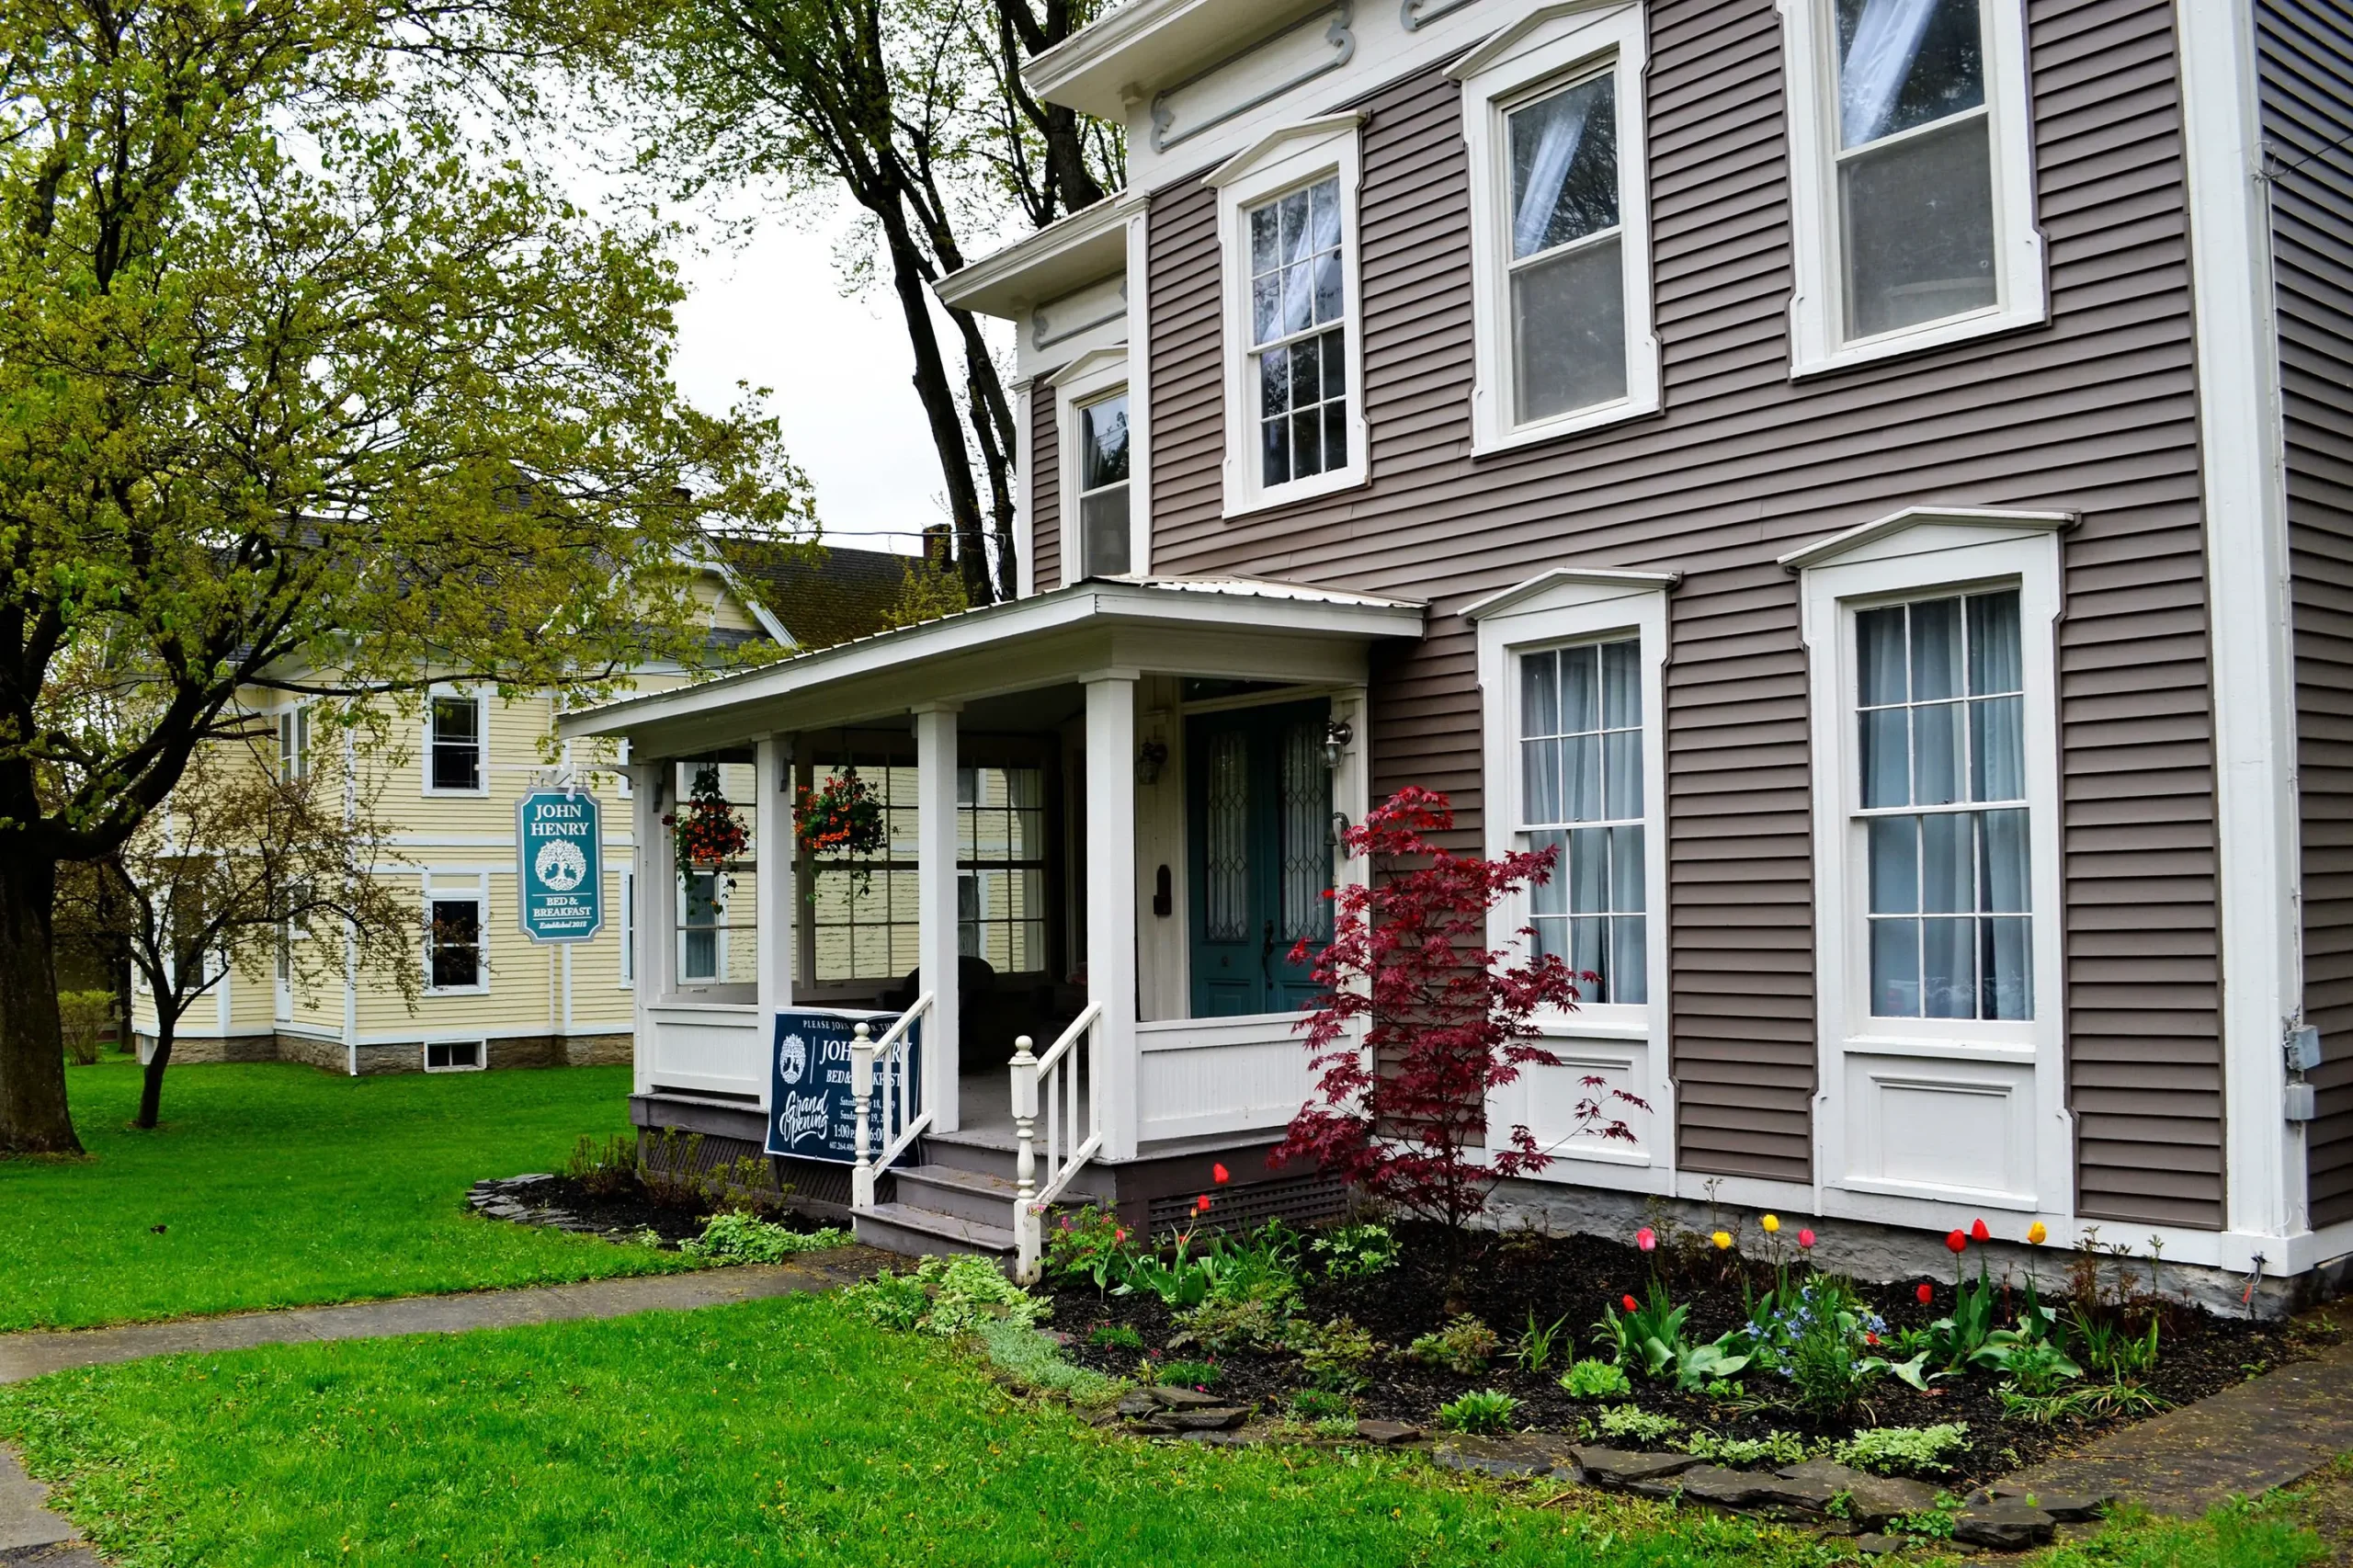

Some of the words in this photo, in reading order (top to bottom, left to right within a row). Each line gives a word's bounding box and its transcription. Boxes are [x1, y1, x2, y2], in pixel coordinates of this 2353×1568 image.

[534, 804, 582, 821] JOHN
[530, 822, 589, 836] HENRY
[546, 897, 567, 906] BED
[569, 896, 579, 905] &
[533, 906, 592, 917] BREAKFAST
[802, 1019, 831, 1029] PLEASE
[819, 1040, 852, 1065] JOH
[786, 1088, 829, 1122] Grand
[779, 1110, 829, 1150] Opening
[834, 1124, 850, 1139] 1:00
